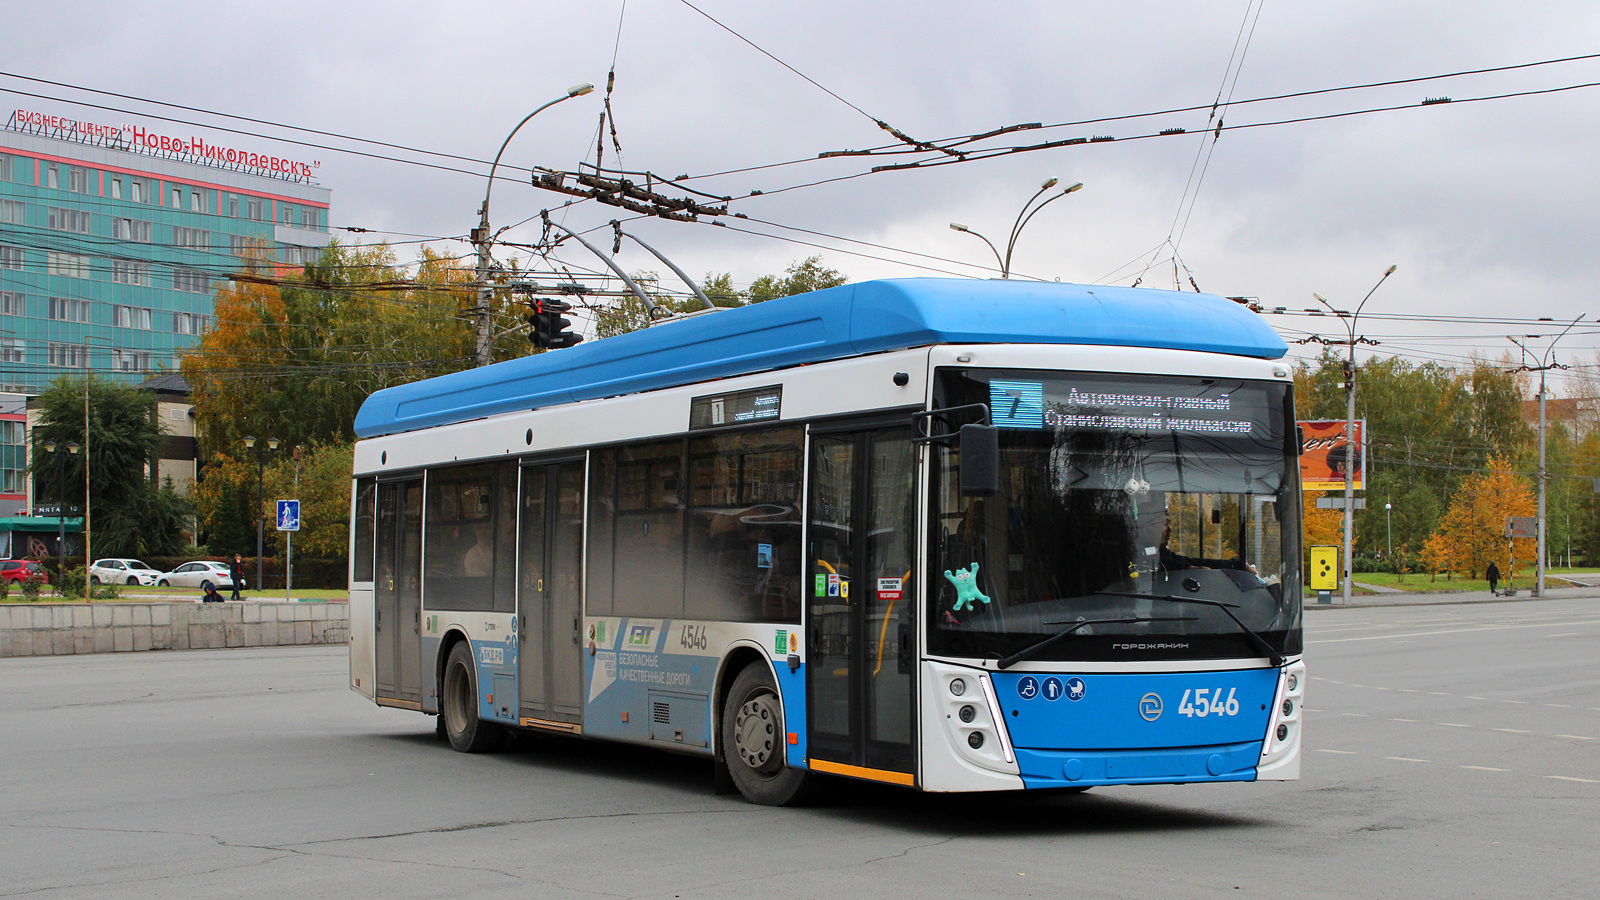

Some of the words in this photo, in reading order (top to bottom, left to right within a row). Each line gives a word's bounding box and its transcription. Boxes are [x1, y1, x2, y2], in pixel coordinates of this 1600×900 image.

[680, 624, 707, 650] 4546
[619, 652, 659, 667] БЕЗОПАСНЫЕ
[619, 668, 665, 685] КАЧЕСТВЕННЫЕ
[665, 672, 691, 687] ДОРОГИ
[1178, 687, 1240, 718] 4546
